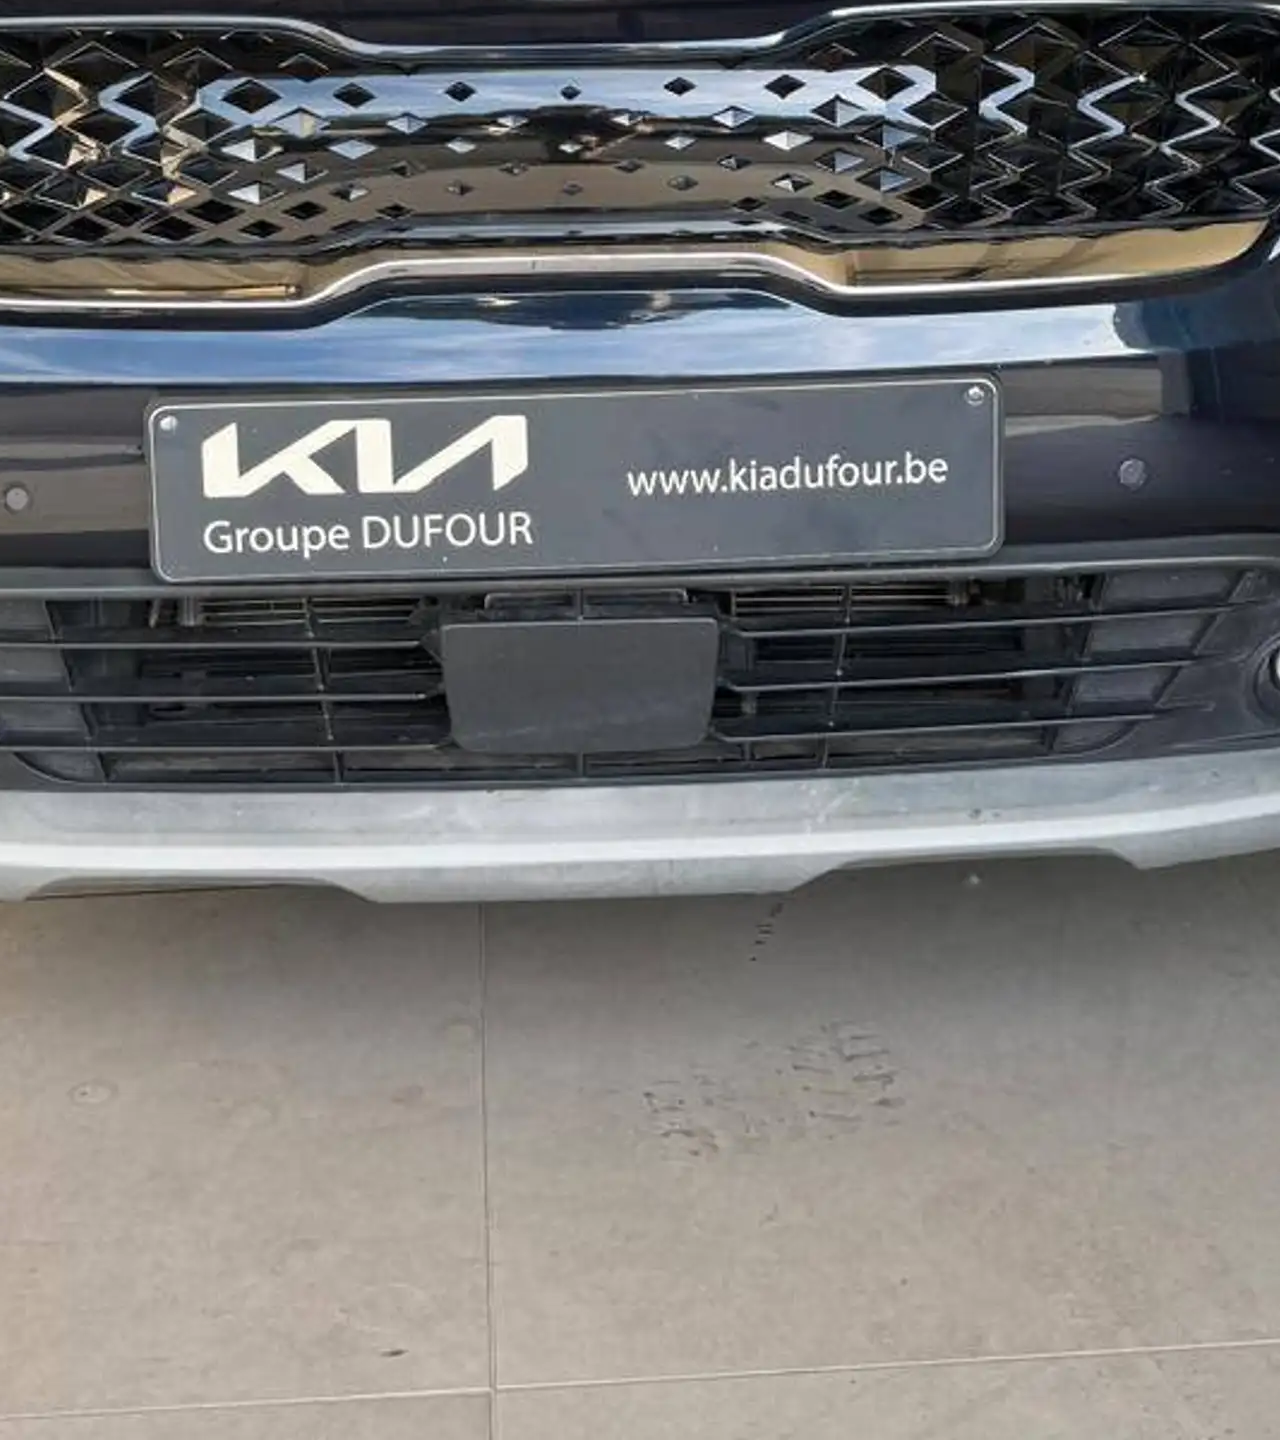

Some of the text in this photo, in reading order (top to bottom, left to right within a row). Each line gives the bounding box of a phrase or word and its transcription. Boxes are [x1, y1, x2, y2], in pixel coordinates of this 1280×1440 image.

[201, 414, 529, 499] KIA
[626, 451, 949, 496] www.kiadufour.be
[203, 510, 534, 559] Groupe DUFOUR
